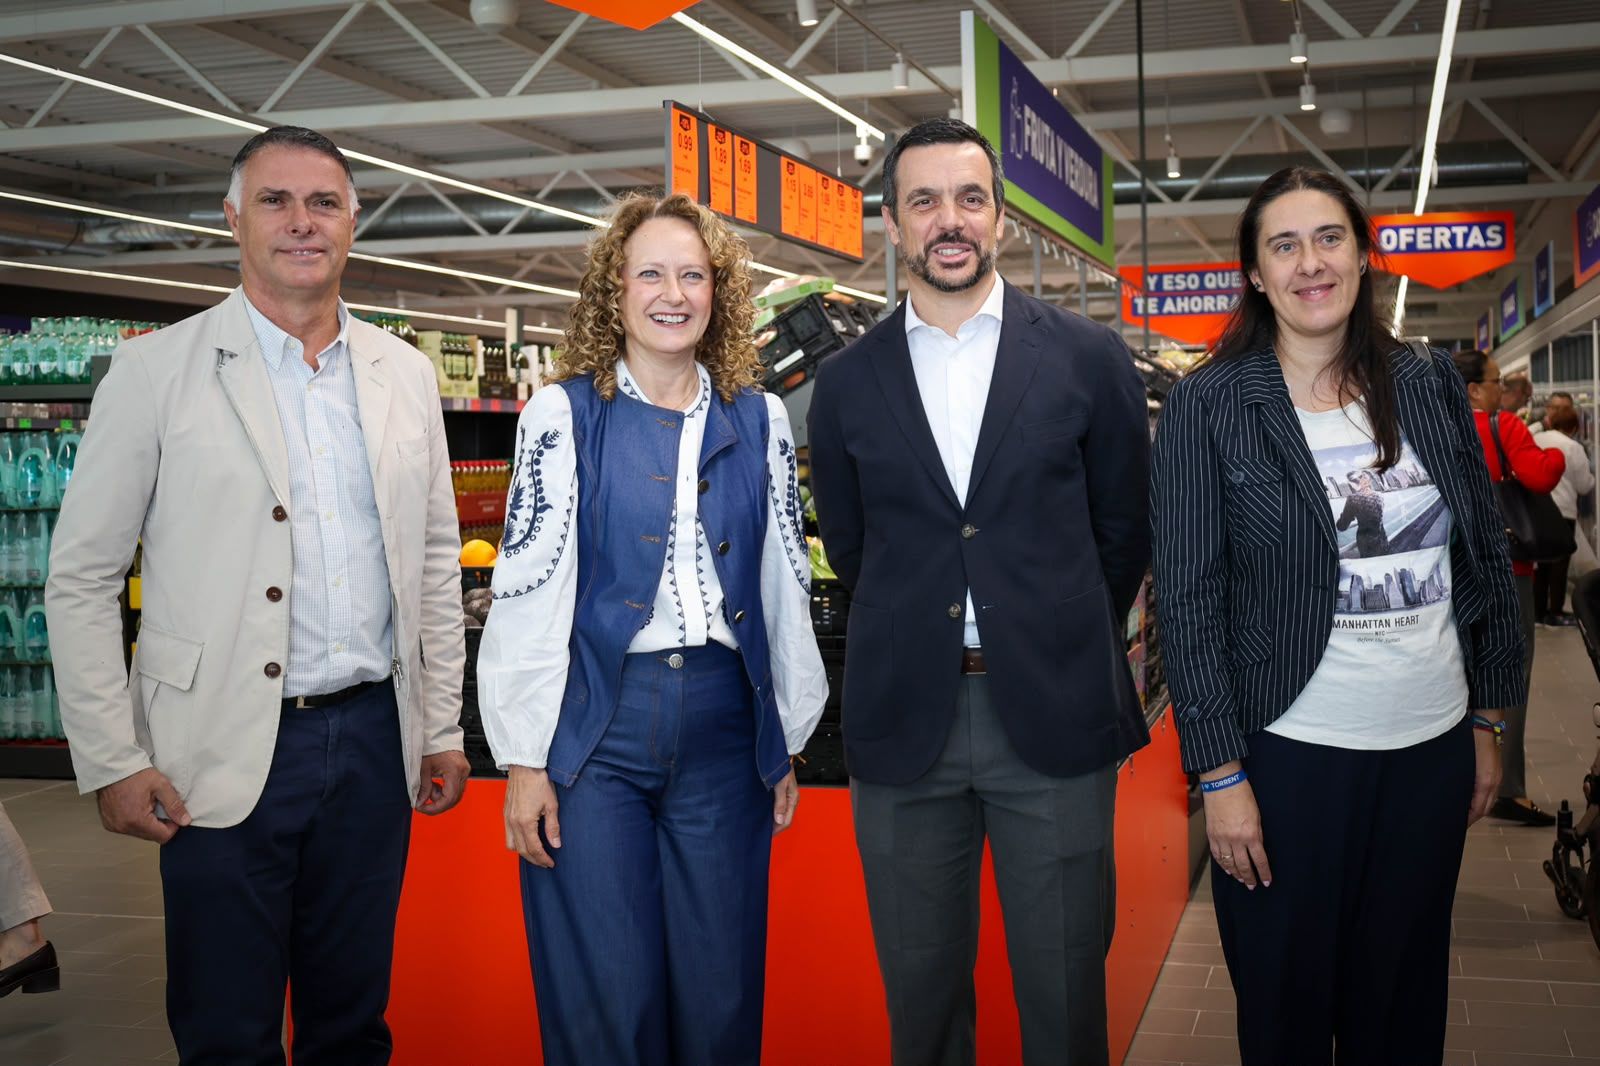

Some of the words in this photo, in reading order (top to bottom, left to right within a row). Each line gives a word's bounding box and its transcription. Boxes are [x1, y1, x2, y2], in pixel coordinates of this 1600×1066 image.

[678, 132, 693, 152] 0.99
[1023, 104, 1057, 177] FRUTA
[1062, 139, 1099, 210] VERDURA
[1380, 225, 1503, 250] OFERTAS
[1147, 275, 1159, 292] Y
[1162, 274, 1200, 291] ESO
[1203, 270, 1242, 290] QUE
[1133, 298, 1159, 314] TE
[1332, 618, 1391, 630] MANHATTAN
[1394, 614, 1420, 628] HEART
[1210, 774, 1240, 789] TORRENT
